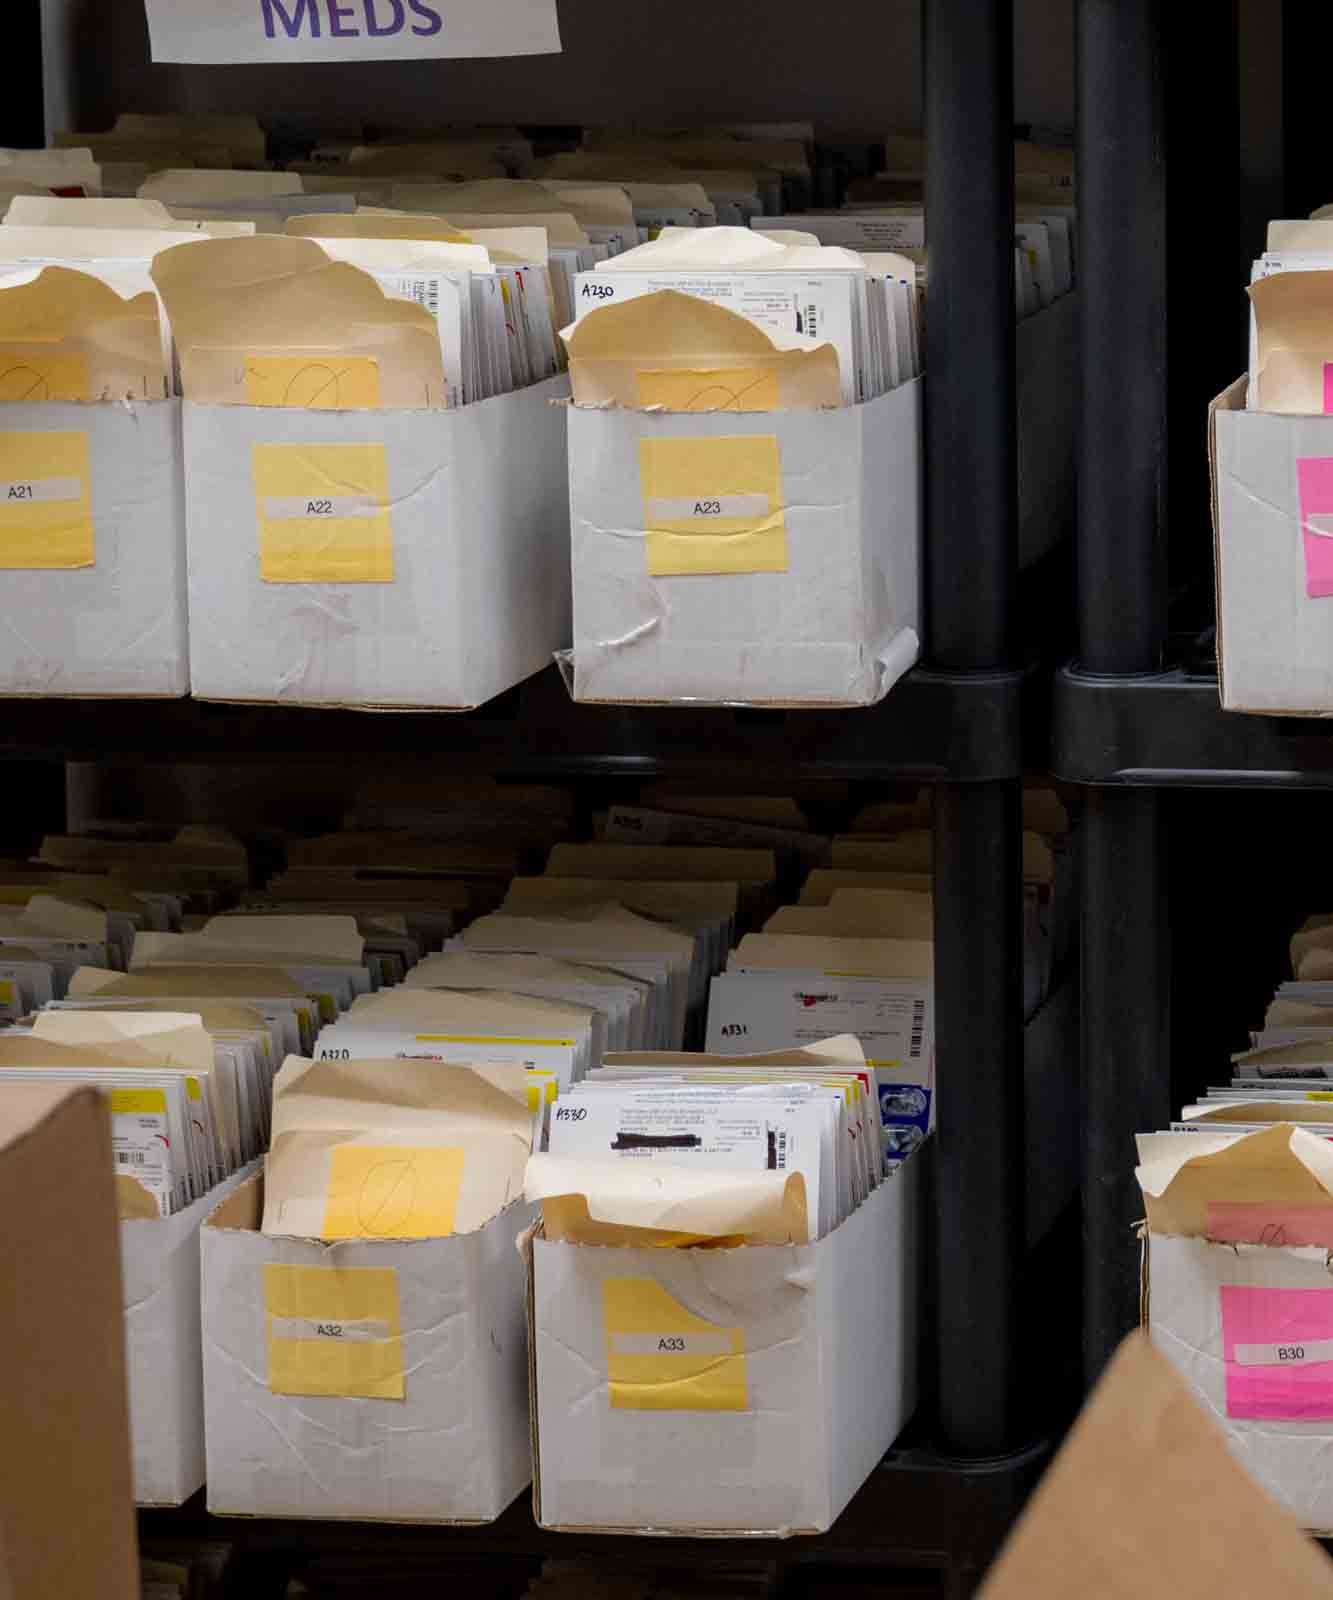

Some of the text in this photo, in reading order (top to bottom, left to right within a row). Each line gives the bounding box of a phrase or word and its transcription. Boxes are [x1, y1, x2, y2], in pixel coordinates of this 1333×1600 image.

[582, 284, 615, 298] A230
[8, 485, 32, 499] A21
[306, 500, 333, 514] A22
[693, 501, 721, 515] A23
[556, 1108, 588, 1120] A330
[317, 1324, 343, 1337] A32
[658, 1338, 685, 1351] A33
[1278, 1346, 1305, 1361] B30
